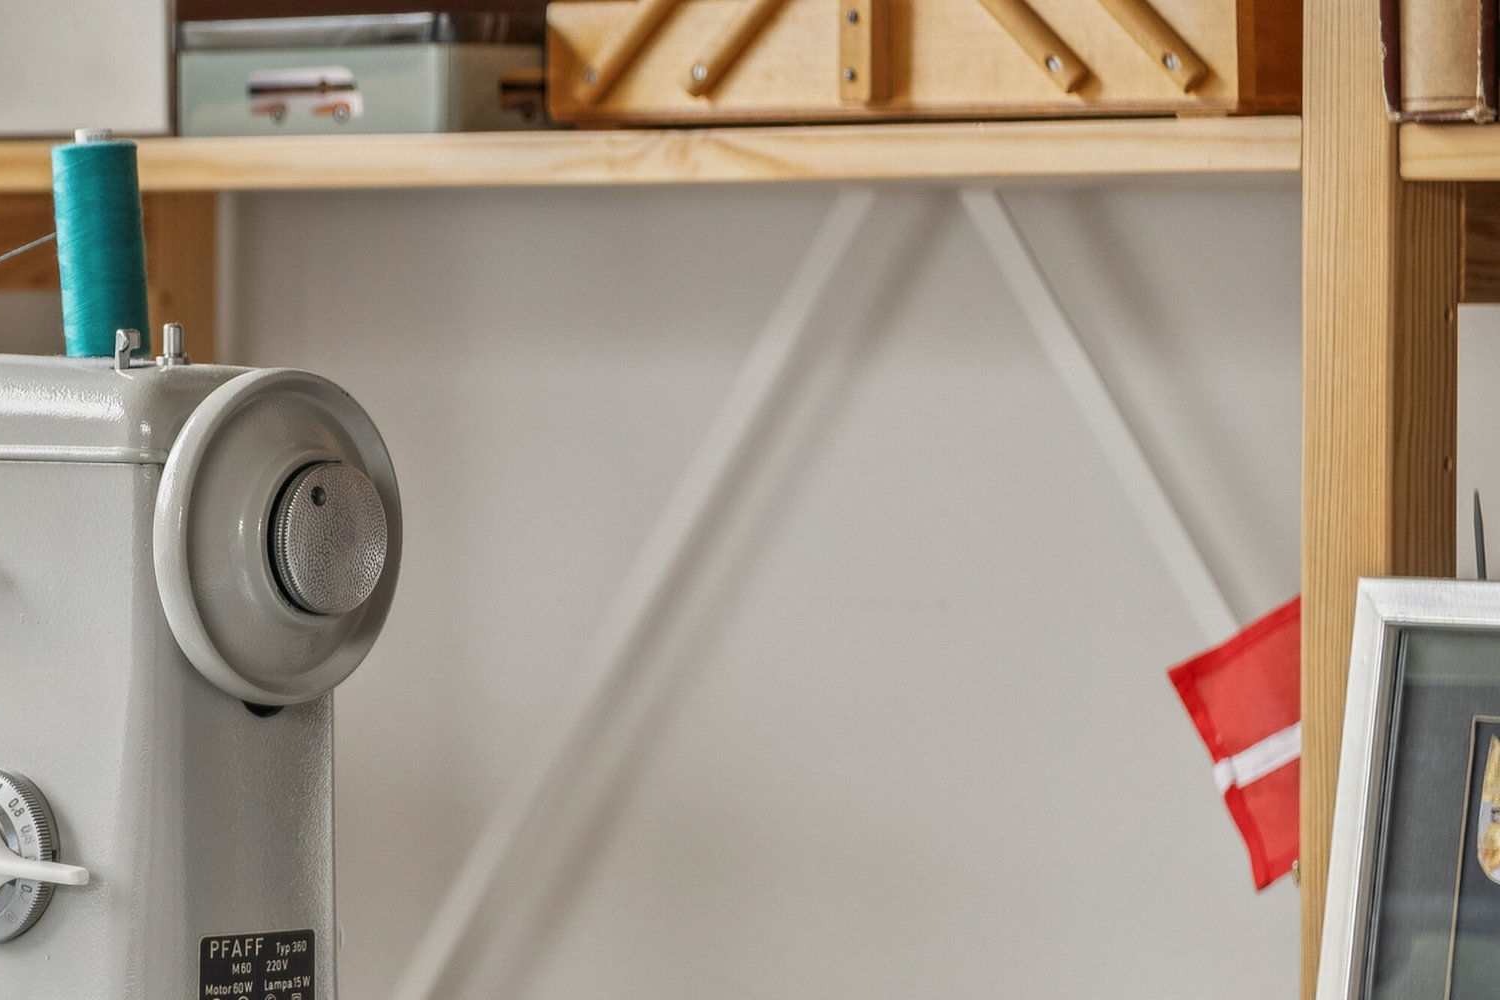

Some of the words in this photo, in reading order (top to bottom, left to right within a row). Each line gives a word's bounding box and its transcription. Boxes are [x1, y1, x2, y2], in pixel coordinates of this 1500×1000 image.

[210, 938, 264, 959] PFAFF
[276, 942, 290, 956] Typ
[292, 940, 307, 953] 360
[205, 984, 232, 996] Motor
[264, 979, 293, 991] Lampa
